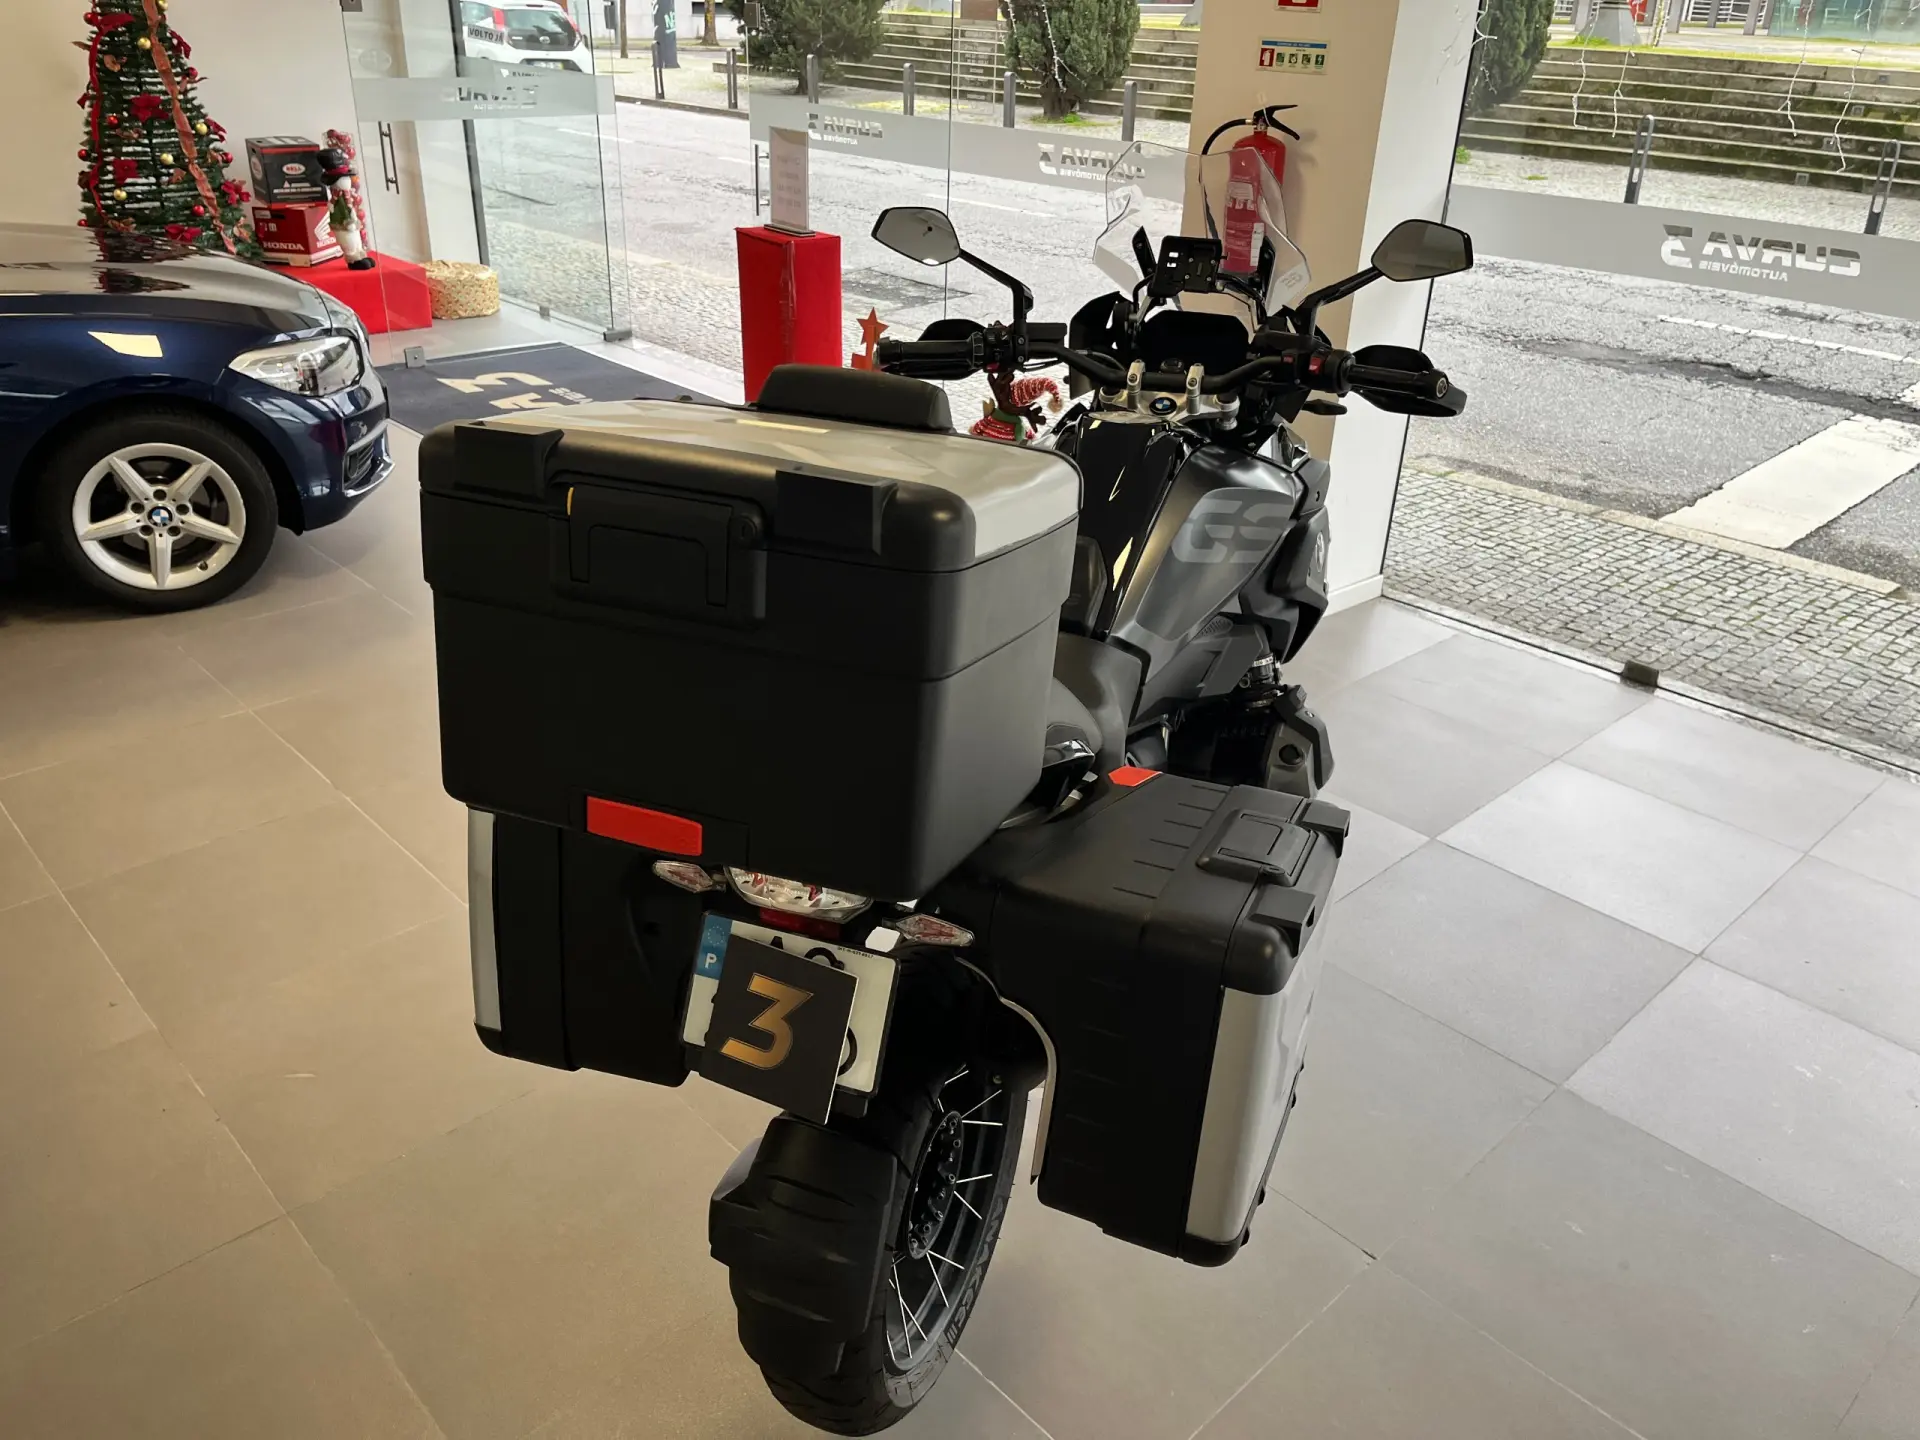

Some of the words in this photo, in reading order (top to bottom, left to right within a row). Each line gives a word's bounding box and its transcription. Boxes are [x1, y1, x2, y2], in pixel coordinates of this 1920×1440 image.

[469, 27, 493, 40] VOLTO
[263, 241, 304, 251] HONDA
[317, 236, 336, 248] HOND
[1172, 500, 1295, 563] GS
[704, 953, 717, 968] P
[721, 972, 814, 1070] 3
